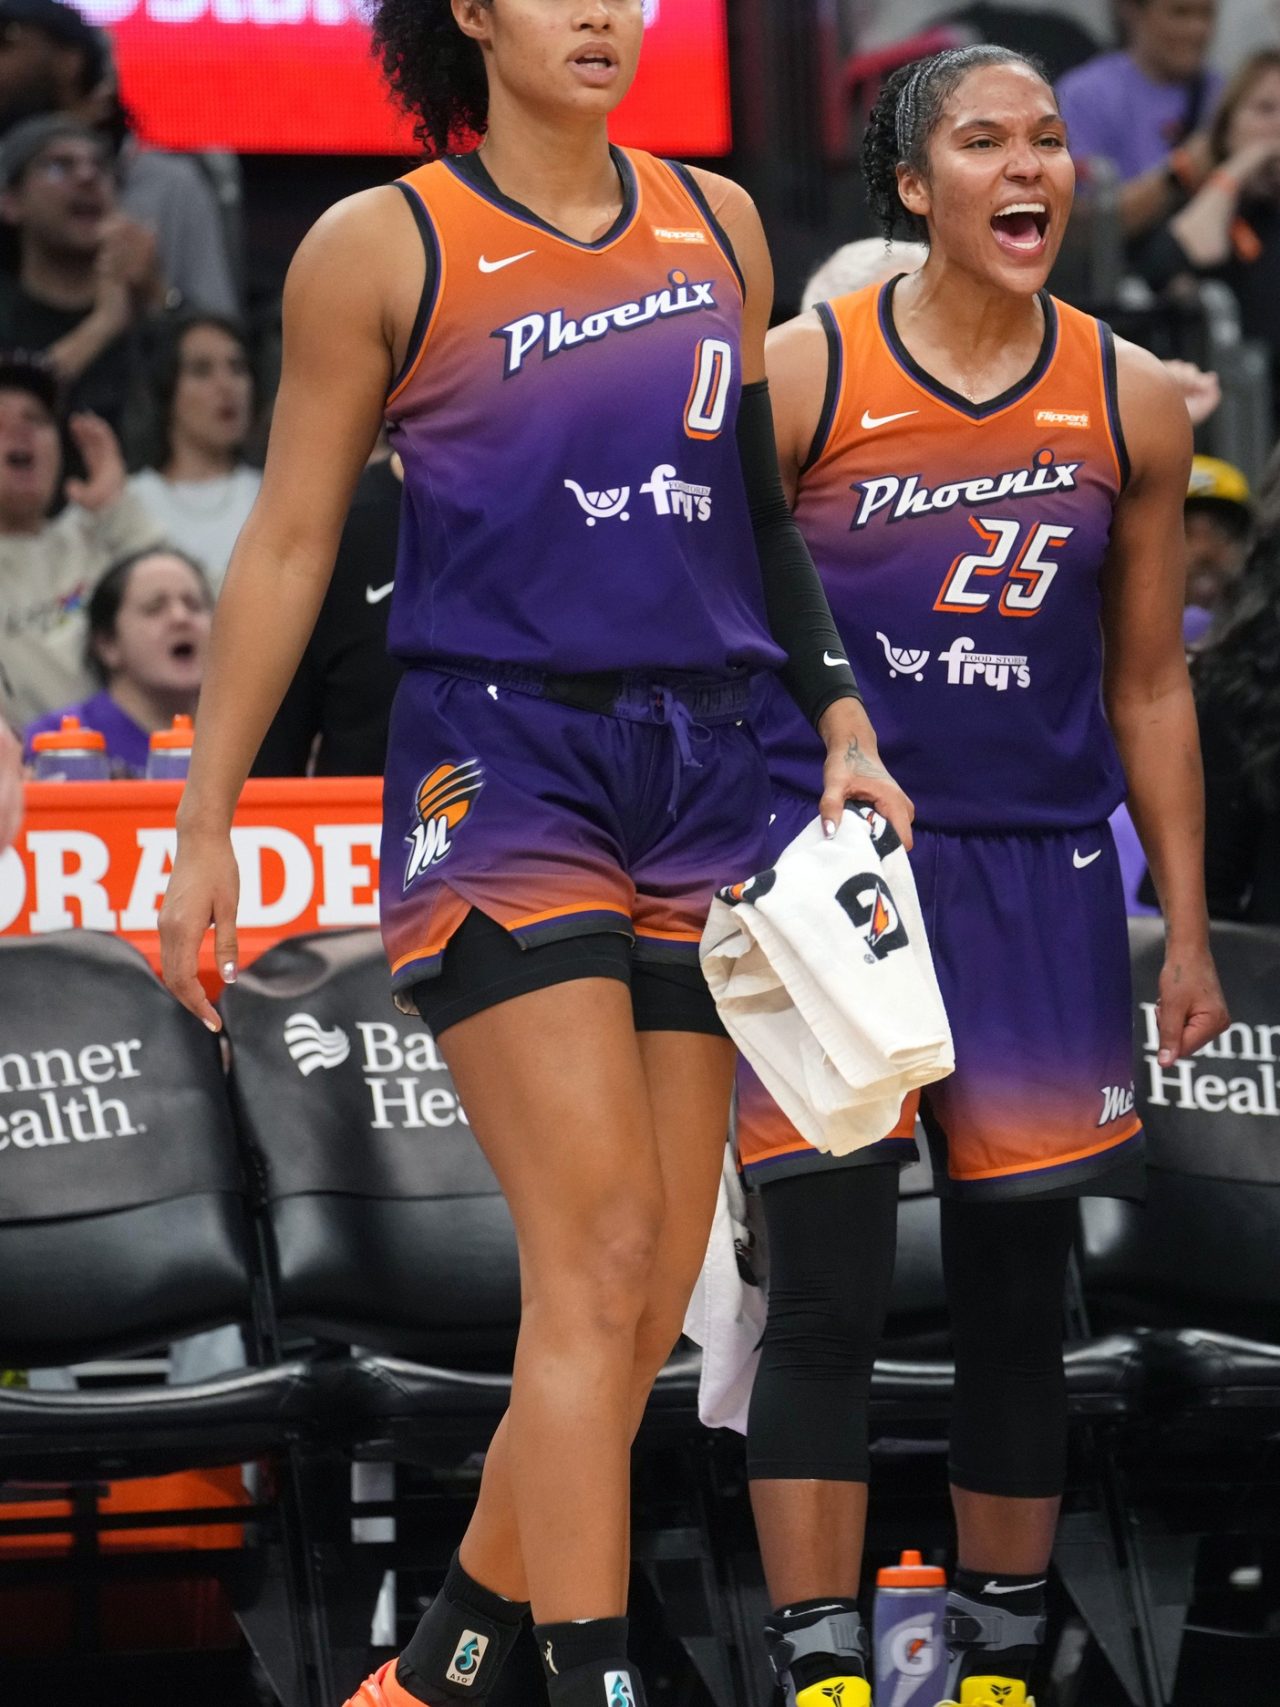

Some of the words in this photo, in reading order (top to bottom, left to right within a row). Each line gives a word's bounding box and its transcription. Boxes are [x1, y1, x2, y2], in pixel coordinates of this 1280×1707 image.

[492, 269, 717, 381] Phoenix
[685, 337, 732, 441] 0
[850, 448, 1082, 530] Phoenix
[932, 515, 1074, 618] 25
[937, 636, 1032, 692] fry's
[963, 654, 993, 664] FOOD
